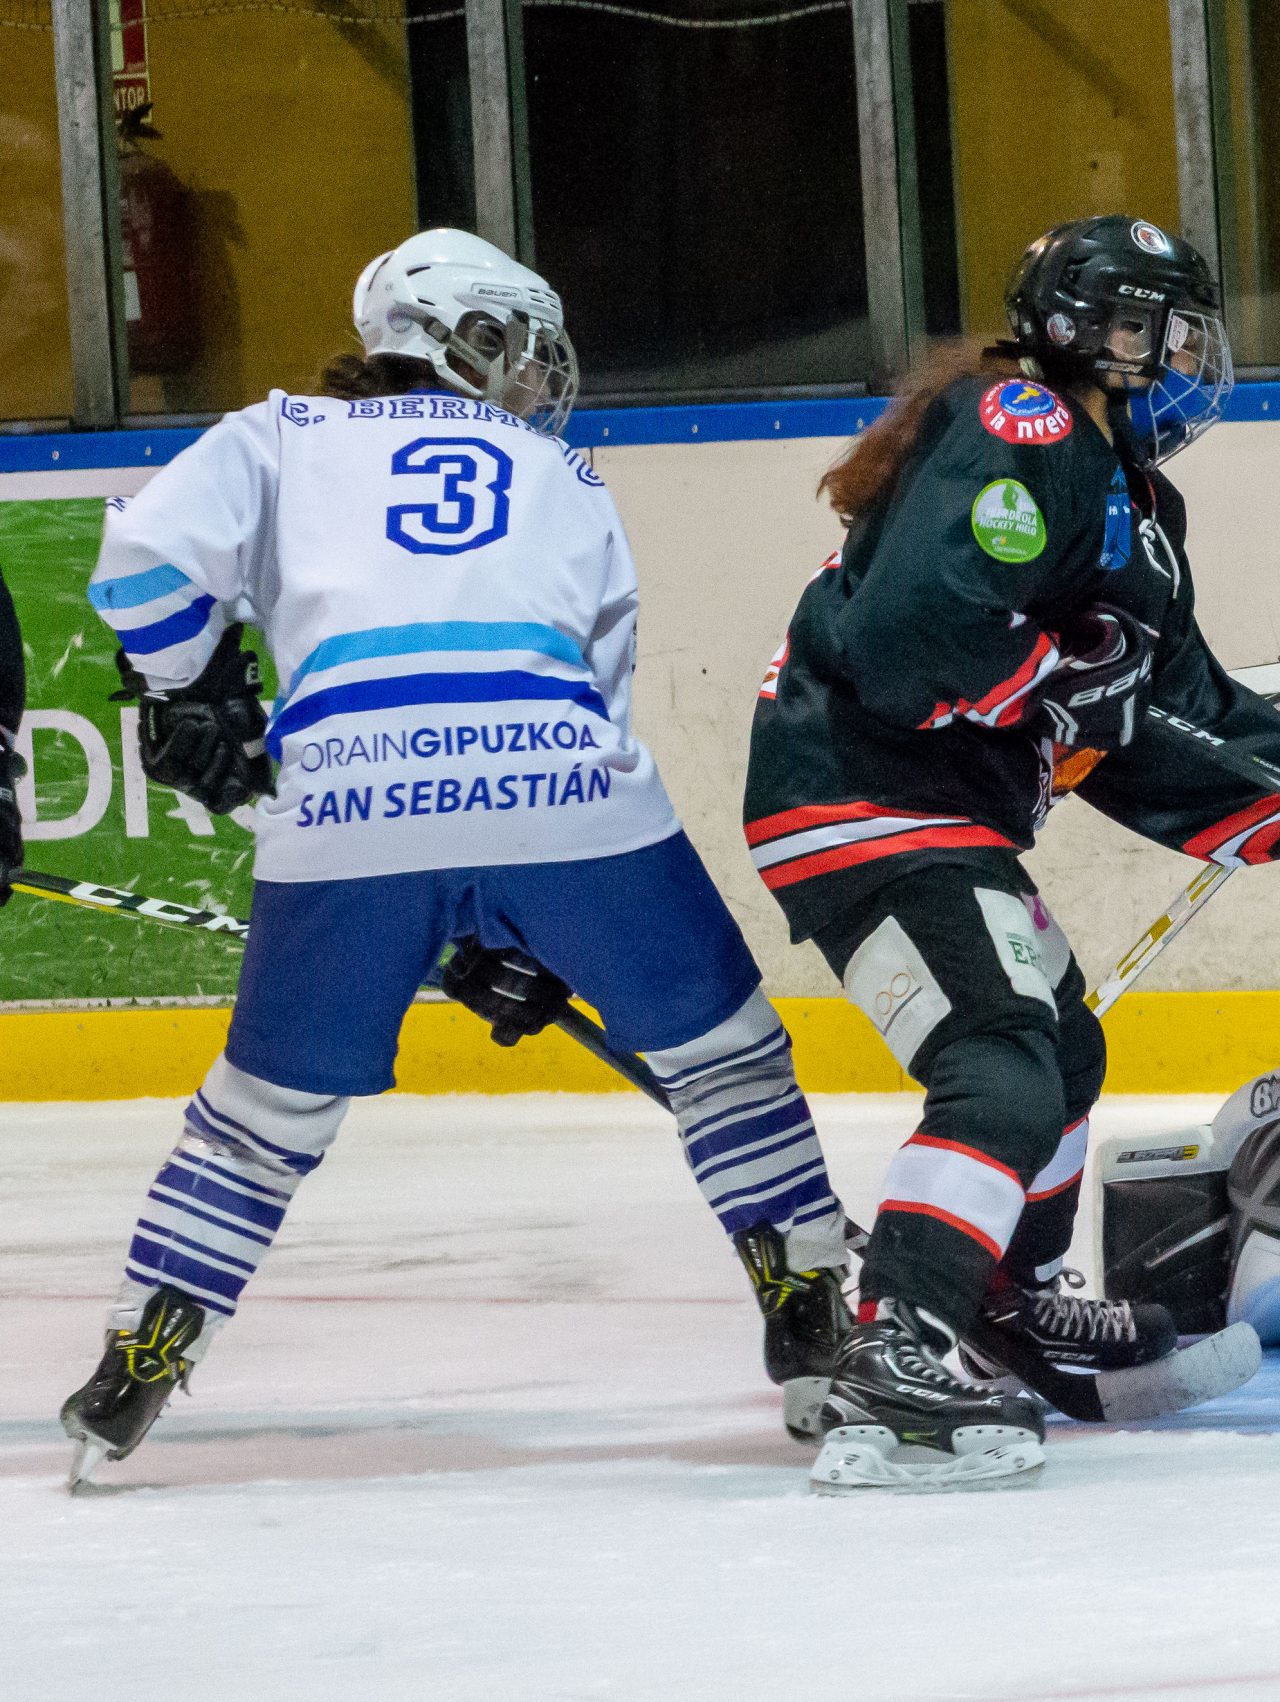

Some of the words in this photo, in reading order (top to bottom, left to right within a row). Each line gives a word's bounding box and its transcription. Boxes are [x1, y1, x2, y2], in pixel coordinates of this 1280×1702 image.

[477, 287, 518, 299] BAUER
[1118, 284, 1166, 303] CCM
[280, 396, 326, 427] C.
[386, 436, 514, 557] 3
[300, 720, 602, 773] ORAINGIPUZKOA
[297, 786, 373, 828] SAN
[383, 762, 611, 819] SEBASTIÁN
[896, 1385, 950, 1401] CCM
